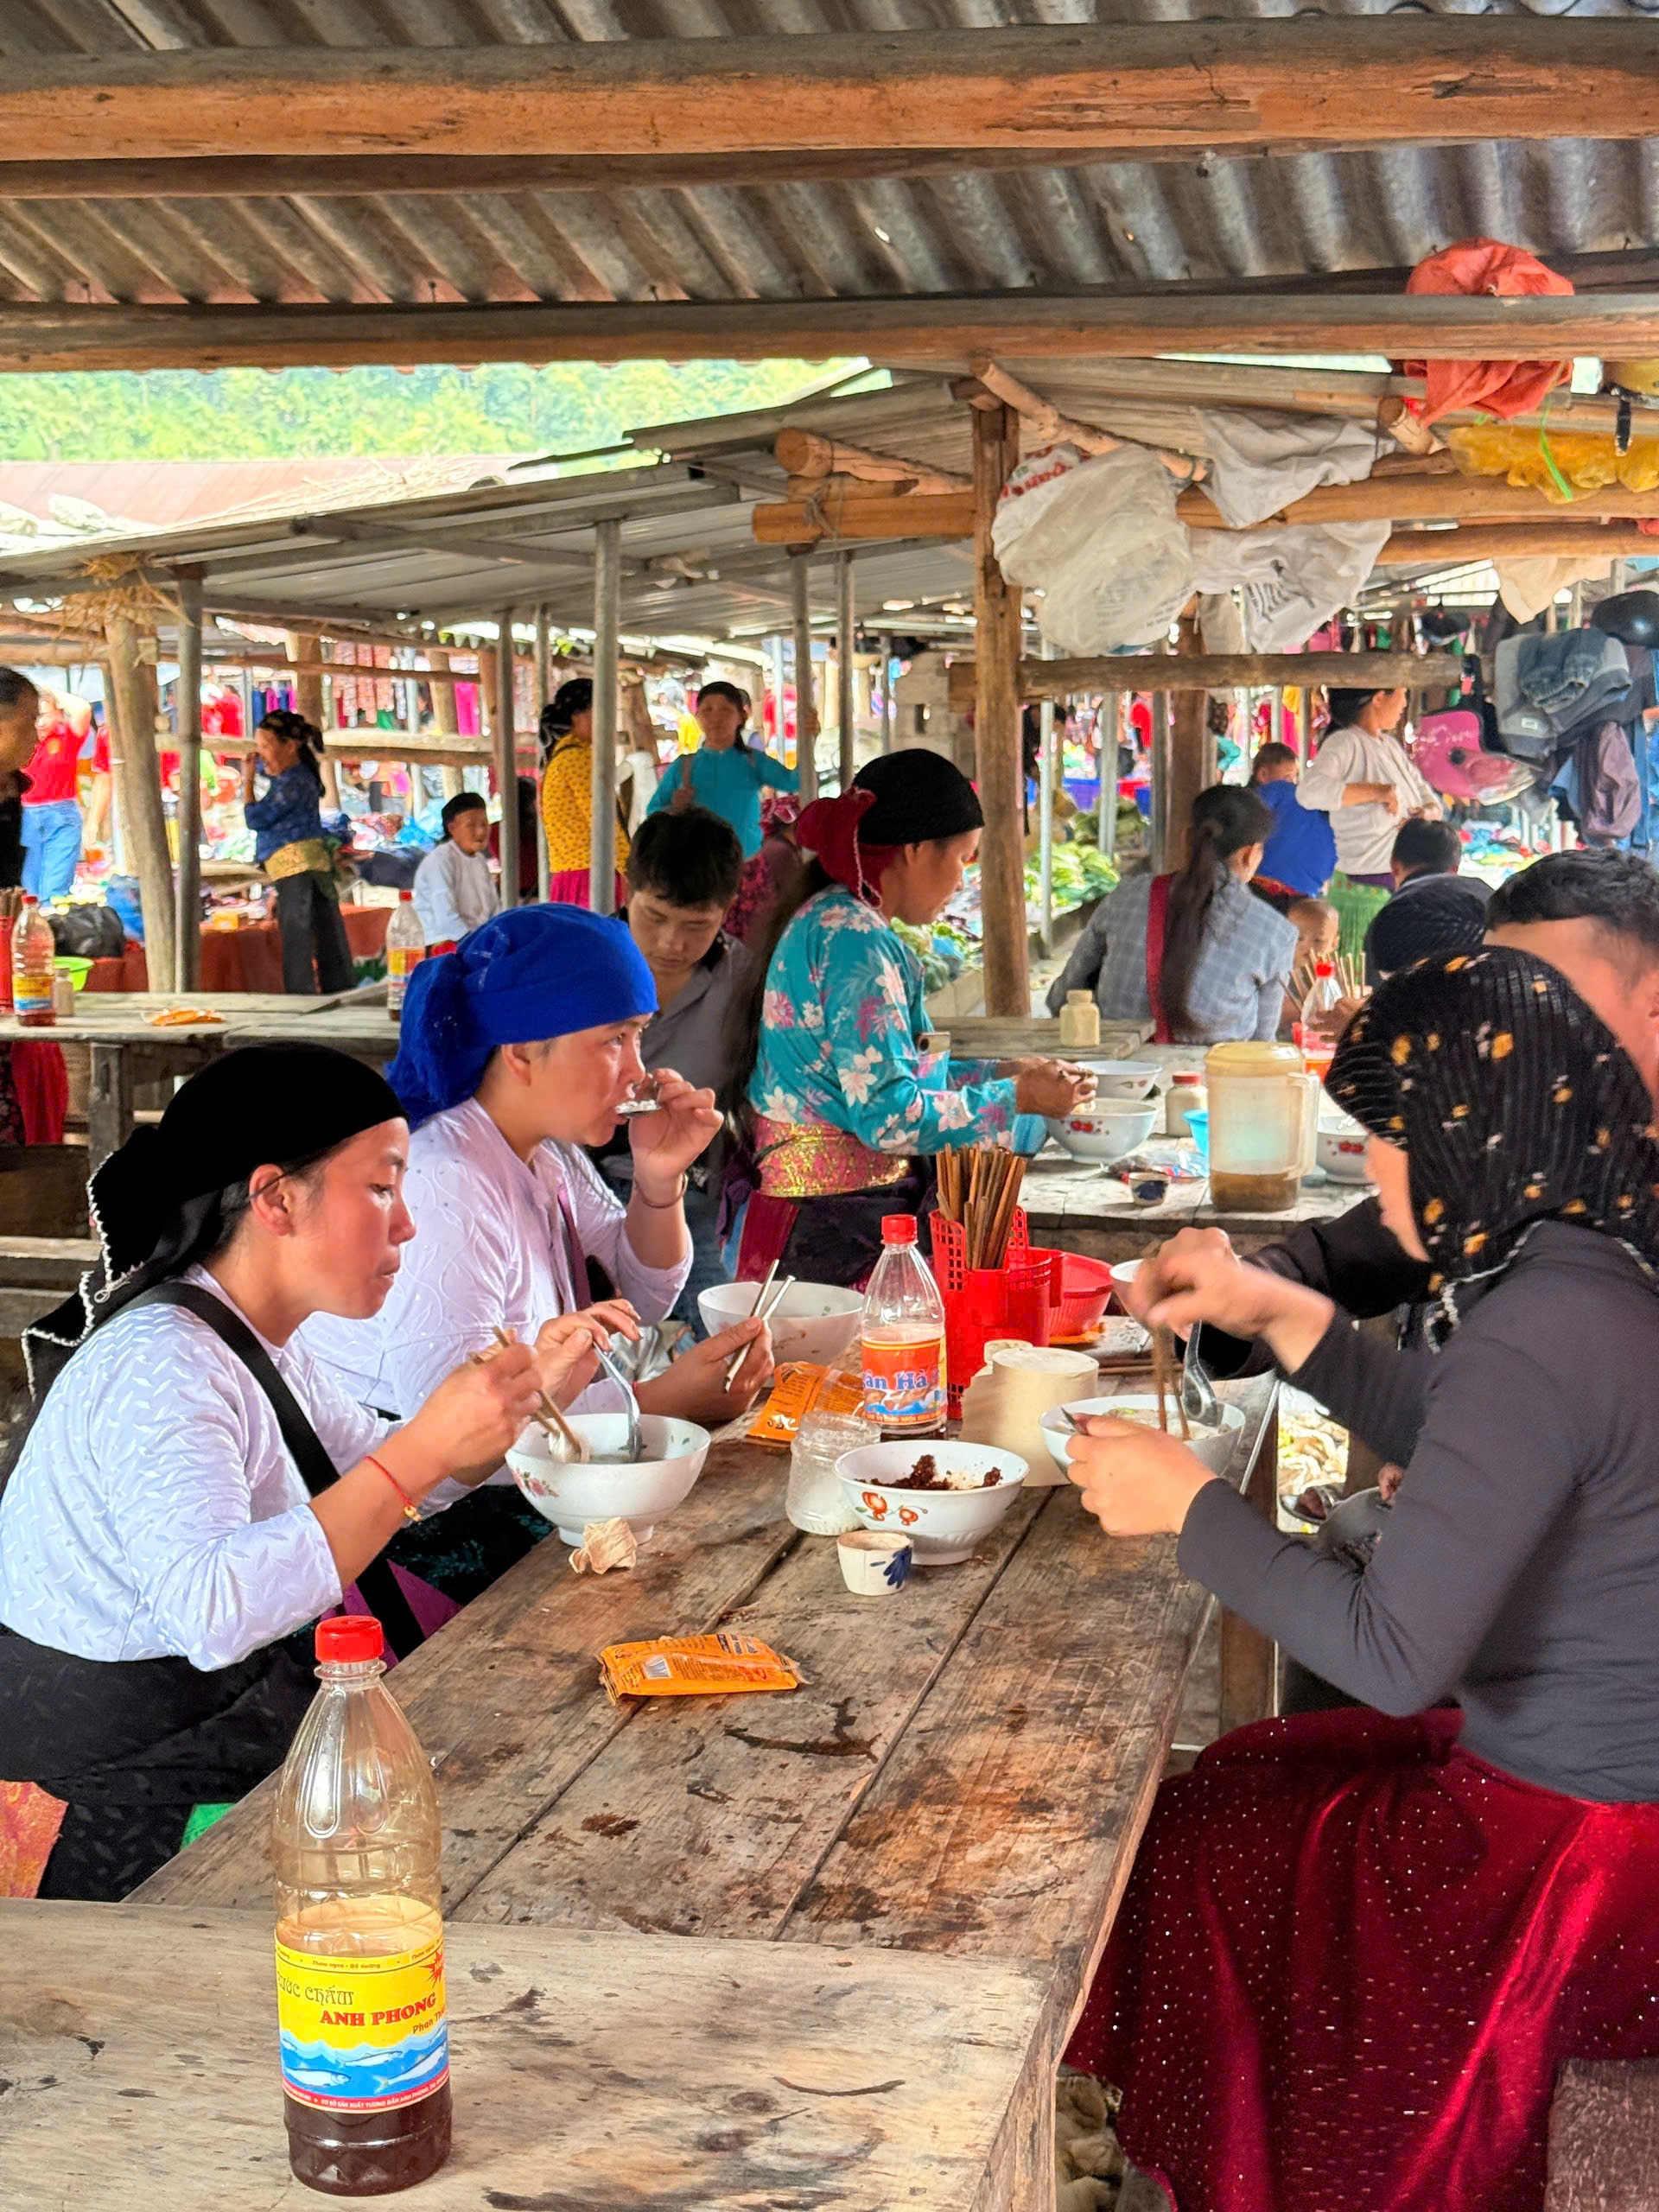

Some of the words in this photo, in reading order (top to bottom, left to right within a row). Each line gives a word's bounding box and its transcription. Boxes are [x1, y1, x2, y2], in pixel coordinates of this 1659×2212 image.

[896, 1370, 927, 1389] Hà
[320, 2010, 365, 2026] ANH
[371, 1992, 436, 2026] PHONG
[412, 2018, 434, 2034] Phan
